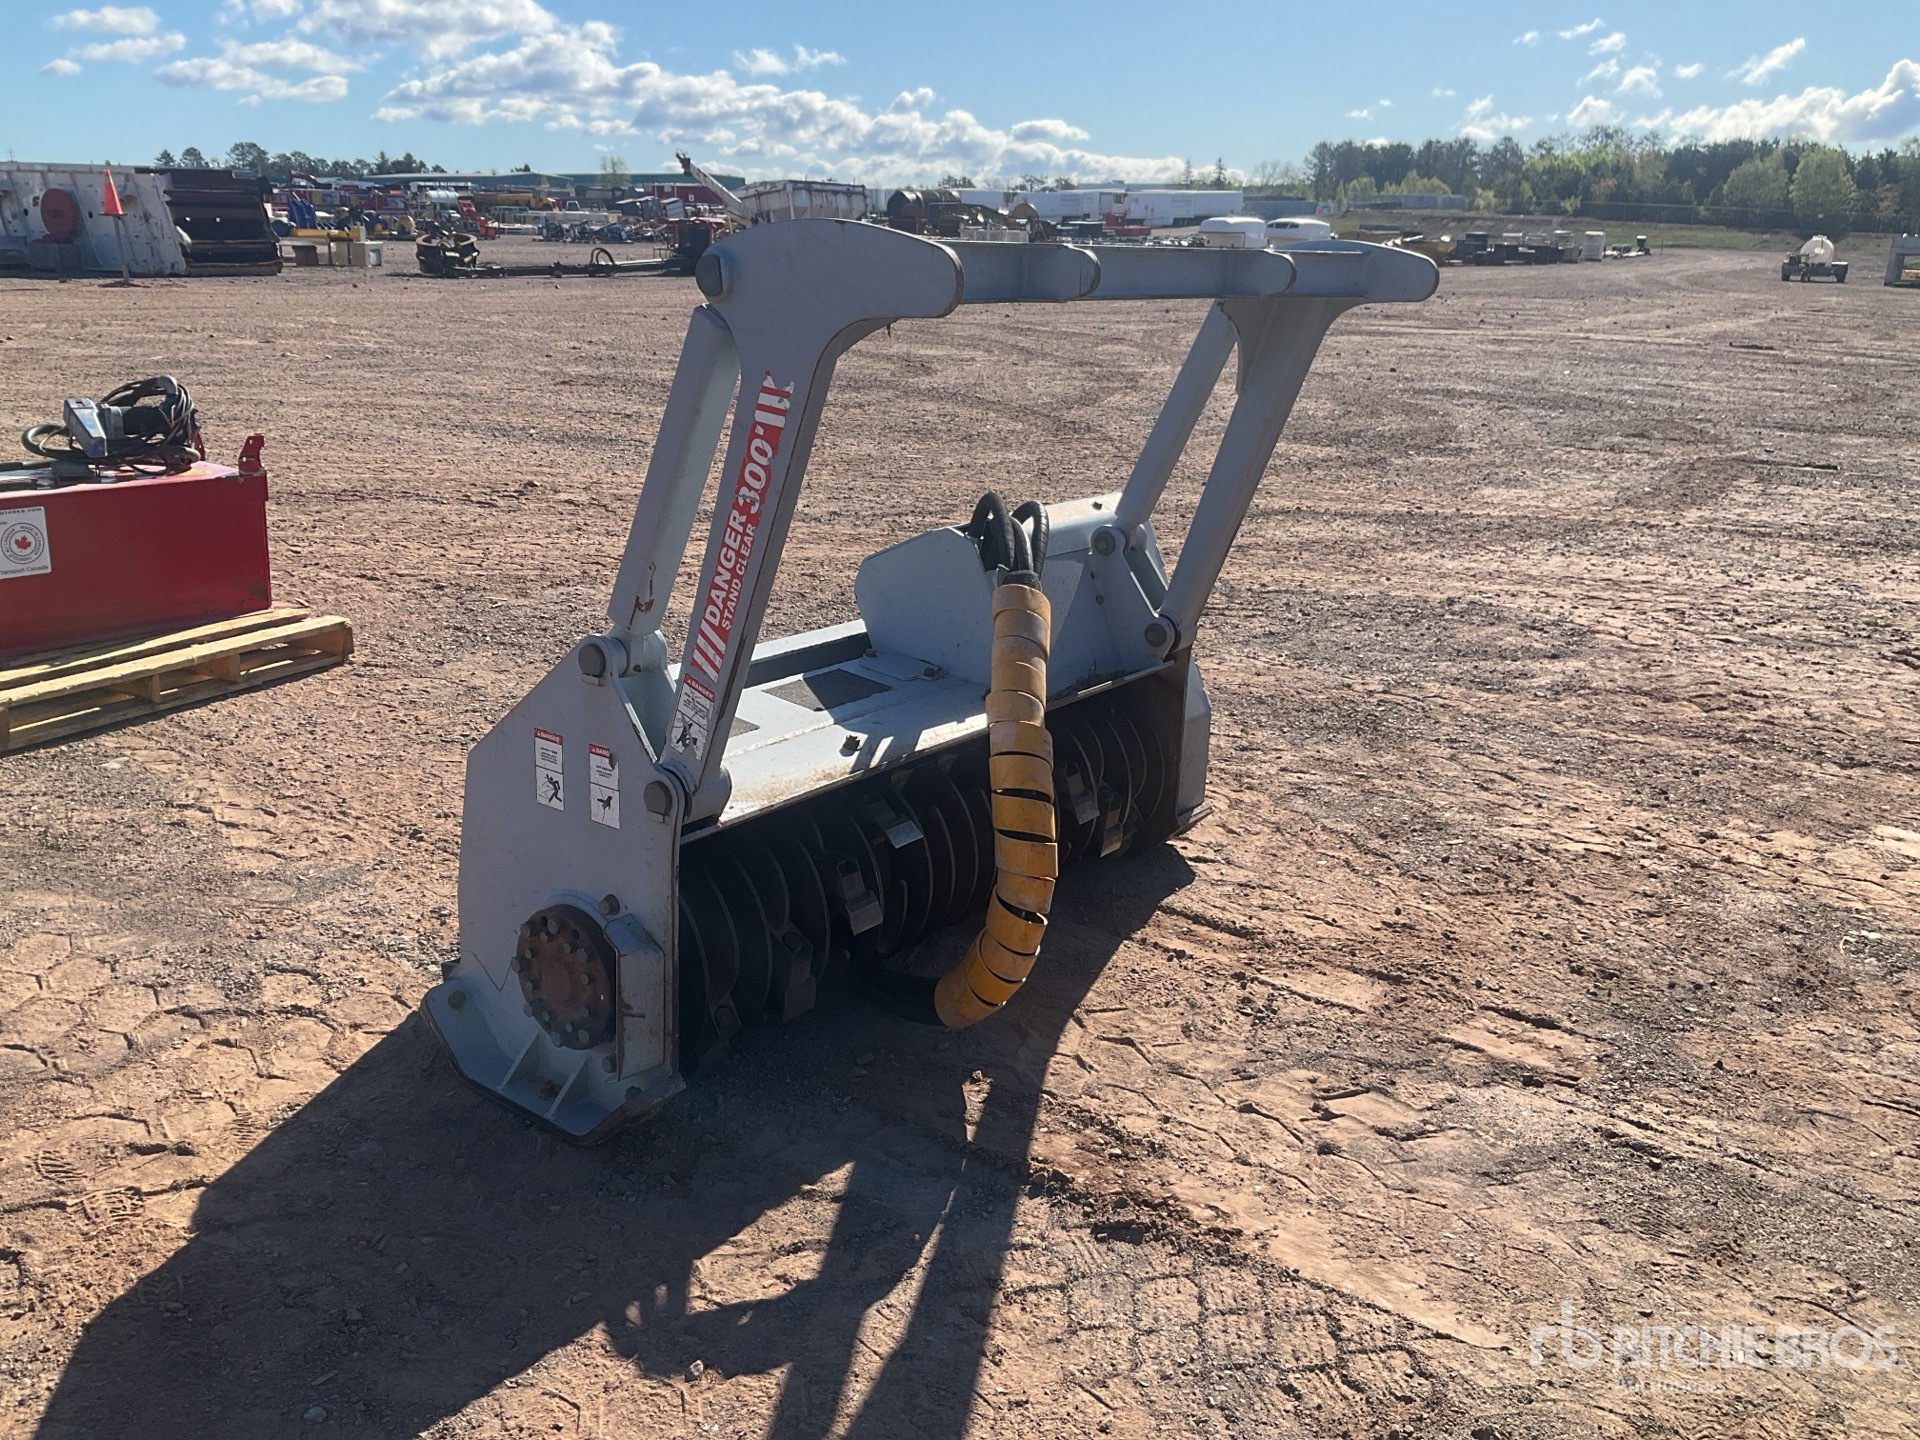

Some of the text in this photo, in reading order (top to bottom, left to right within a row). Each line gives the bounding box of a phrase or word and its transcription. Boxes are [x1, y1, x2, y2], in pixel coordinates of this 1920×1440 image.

[26, 564, 48, 572] Canada
[705, 509, 747, 627] DANGER
[722, 523, 757, 631] STAND CLEAR
[691, 681, 715, 700] DANGER
